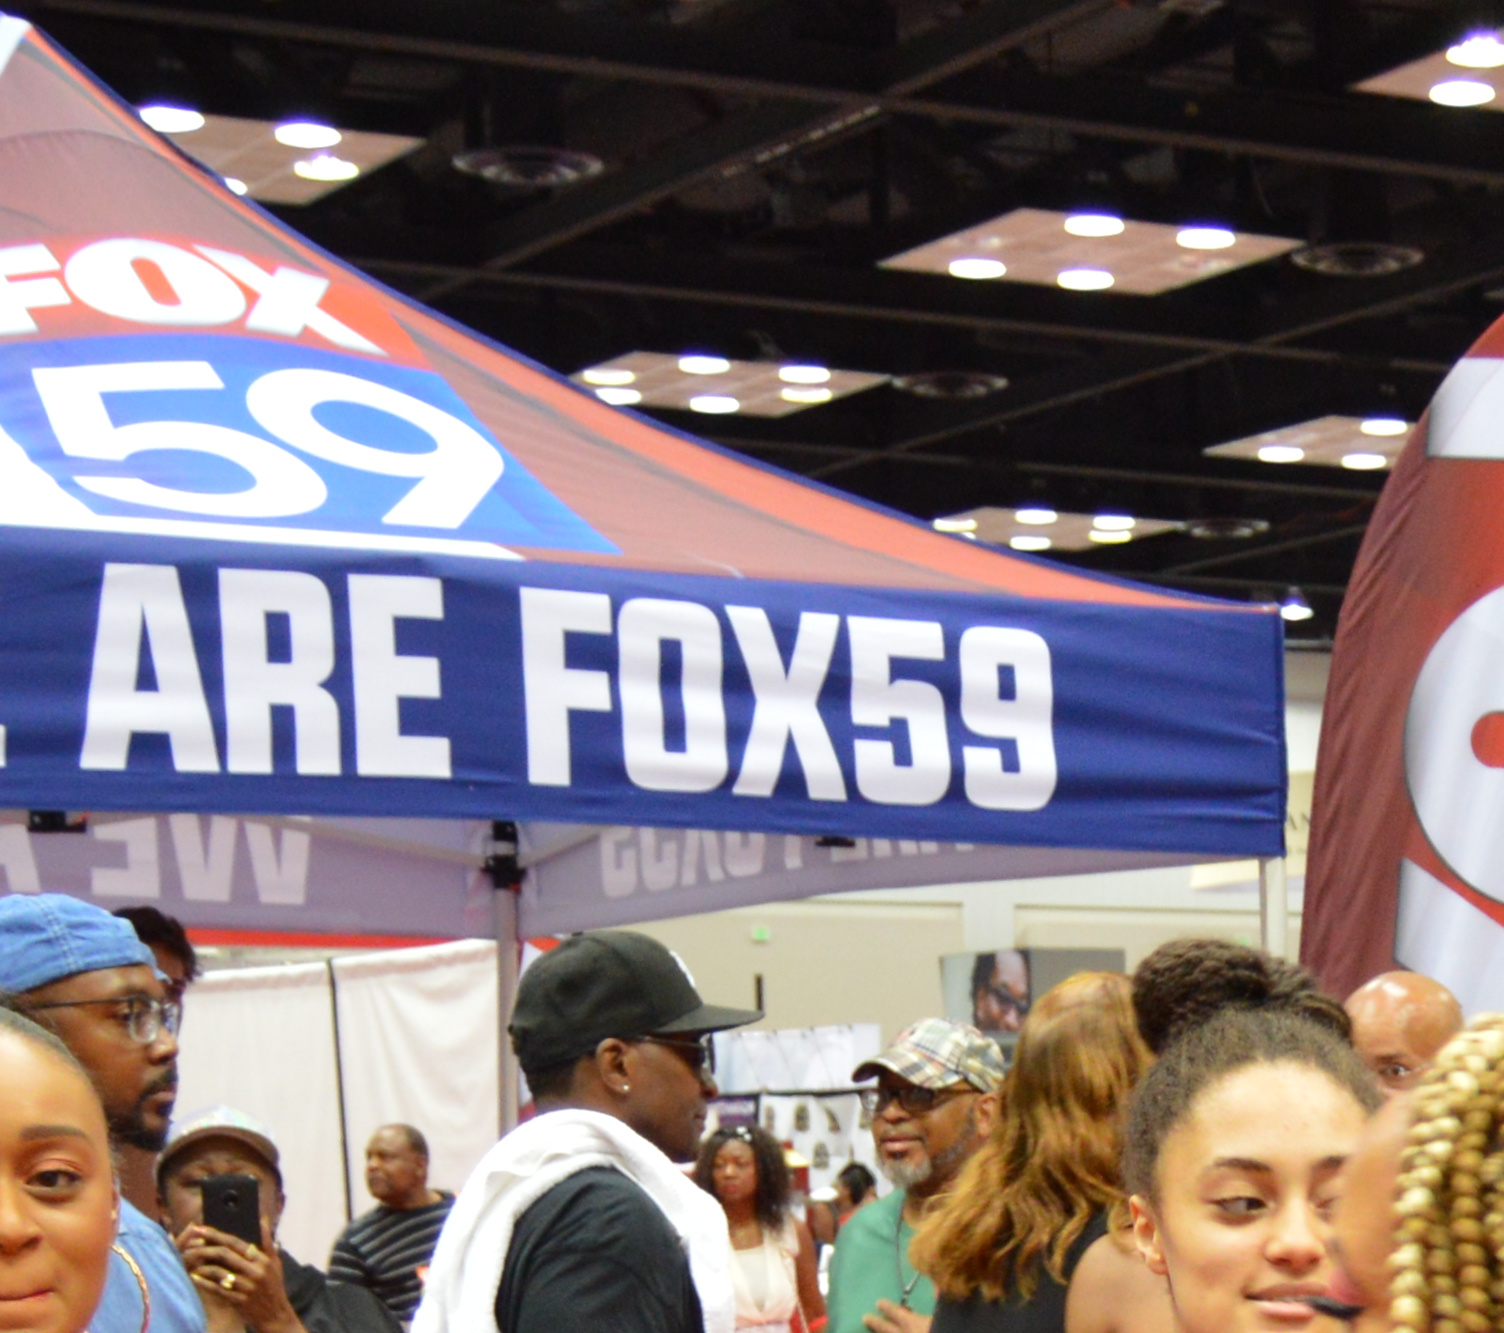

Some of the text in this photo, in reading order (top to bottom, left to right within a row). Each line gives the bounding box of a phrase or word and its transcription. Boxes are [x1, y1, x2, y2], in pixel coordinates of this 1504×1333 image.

[31, 359, 505, 529] 59
[79, 561, 453, 779] ARE
[520, 586, 1059, 813] FOX59
